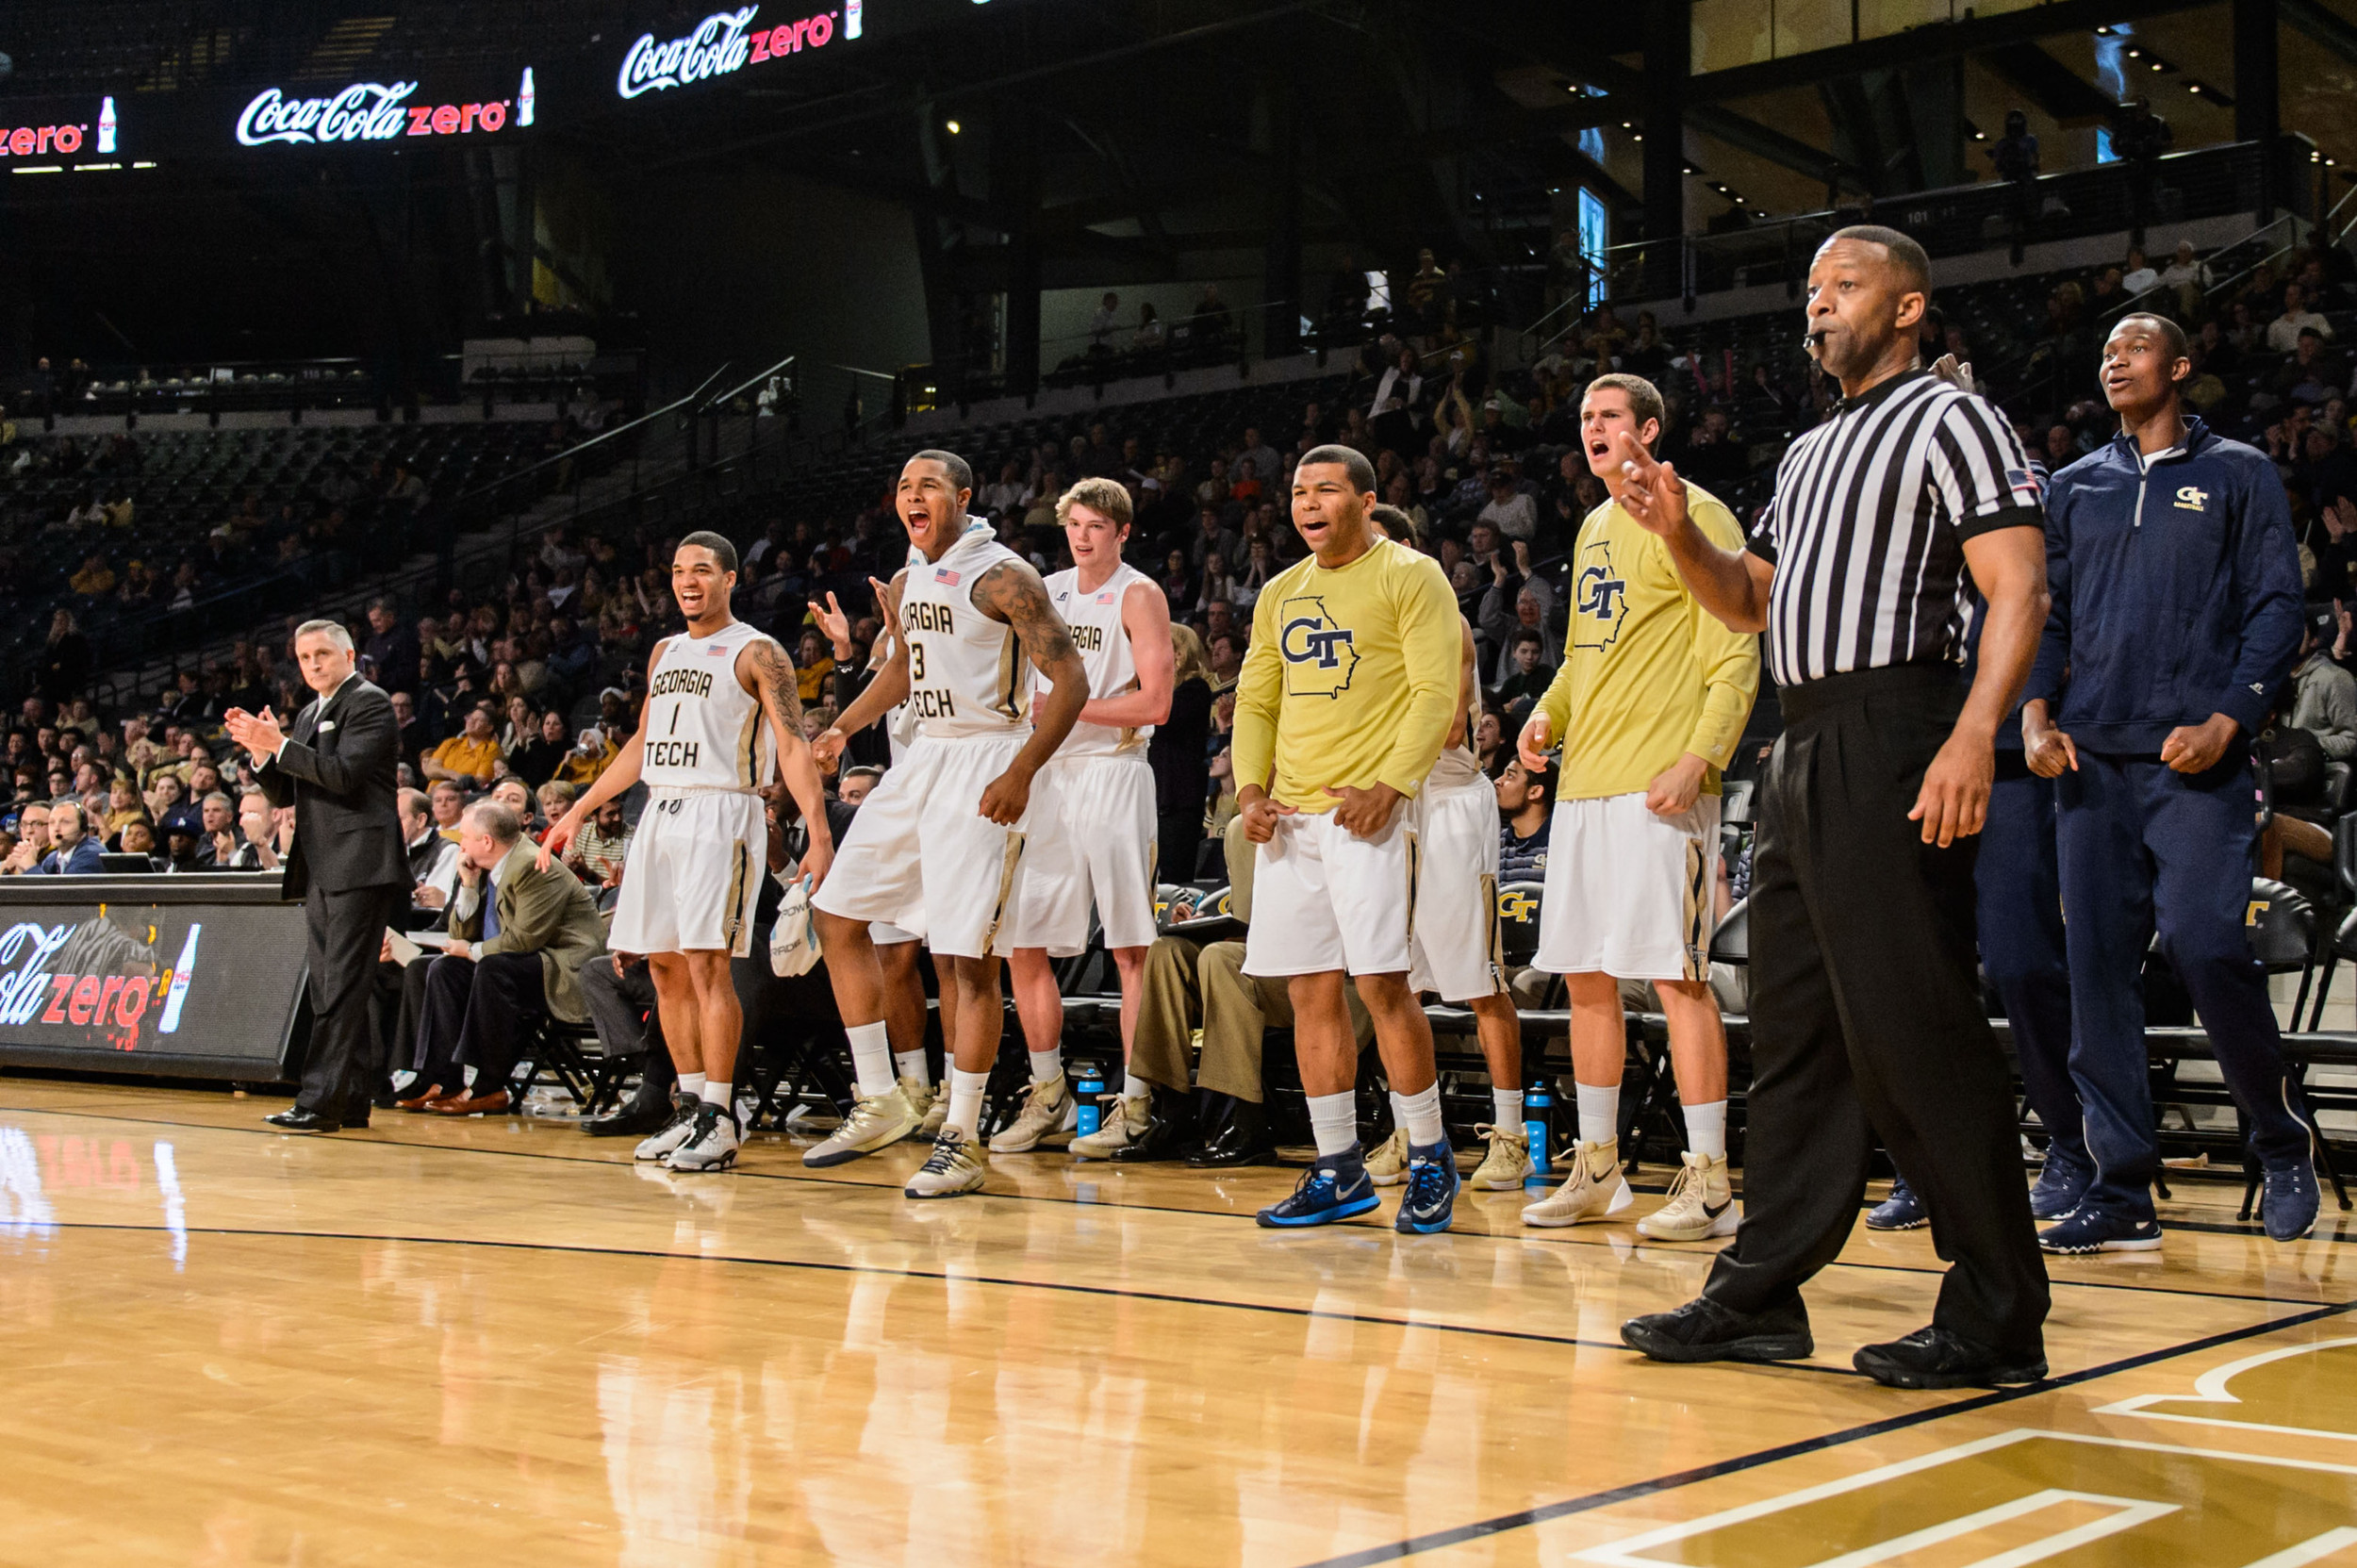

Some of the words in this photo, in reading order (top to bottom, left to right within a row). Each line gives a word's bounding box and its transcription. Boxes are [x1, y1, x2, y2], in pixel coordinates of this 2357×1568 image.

[618, 5, 759, 99] Coca-Cola
[750, 13, 833, 64] zero
[237, 81, 418, 146] Coca-Cola
[407, 103, 506, 136] zero
[1576, 566, 1625, 619] GT
[911, 641, 925, 682] 3
[1280, 616, 1354, 669] GT
[651, 668, 713, 699] GEORGIA
[669, 701, 681, 735] 1
[646, 741, 700, 767] TECH
[1498, 891, 1539, 922] GT
[41, 973, 153, 1028] zero
